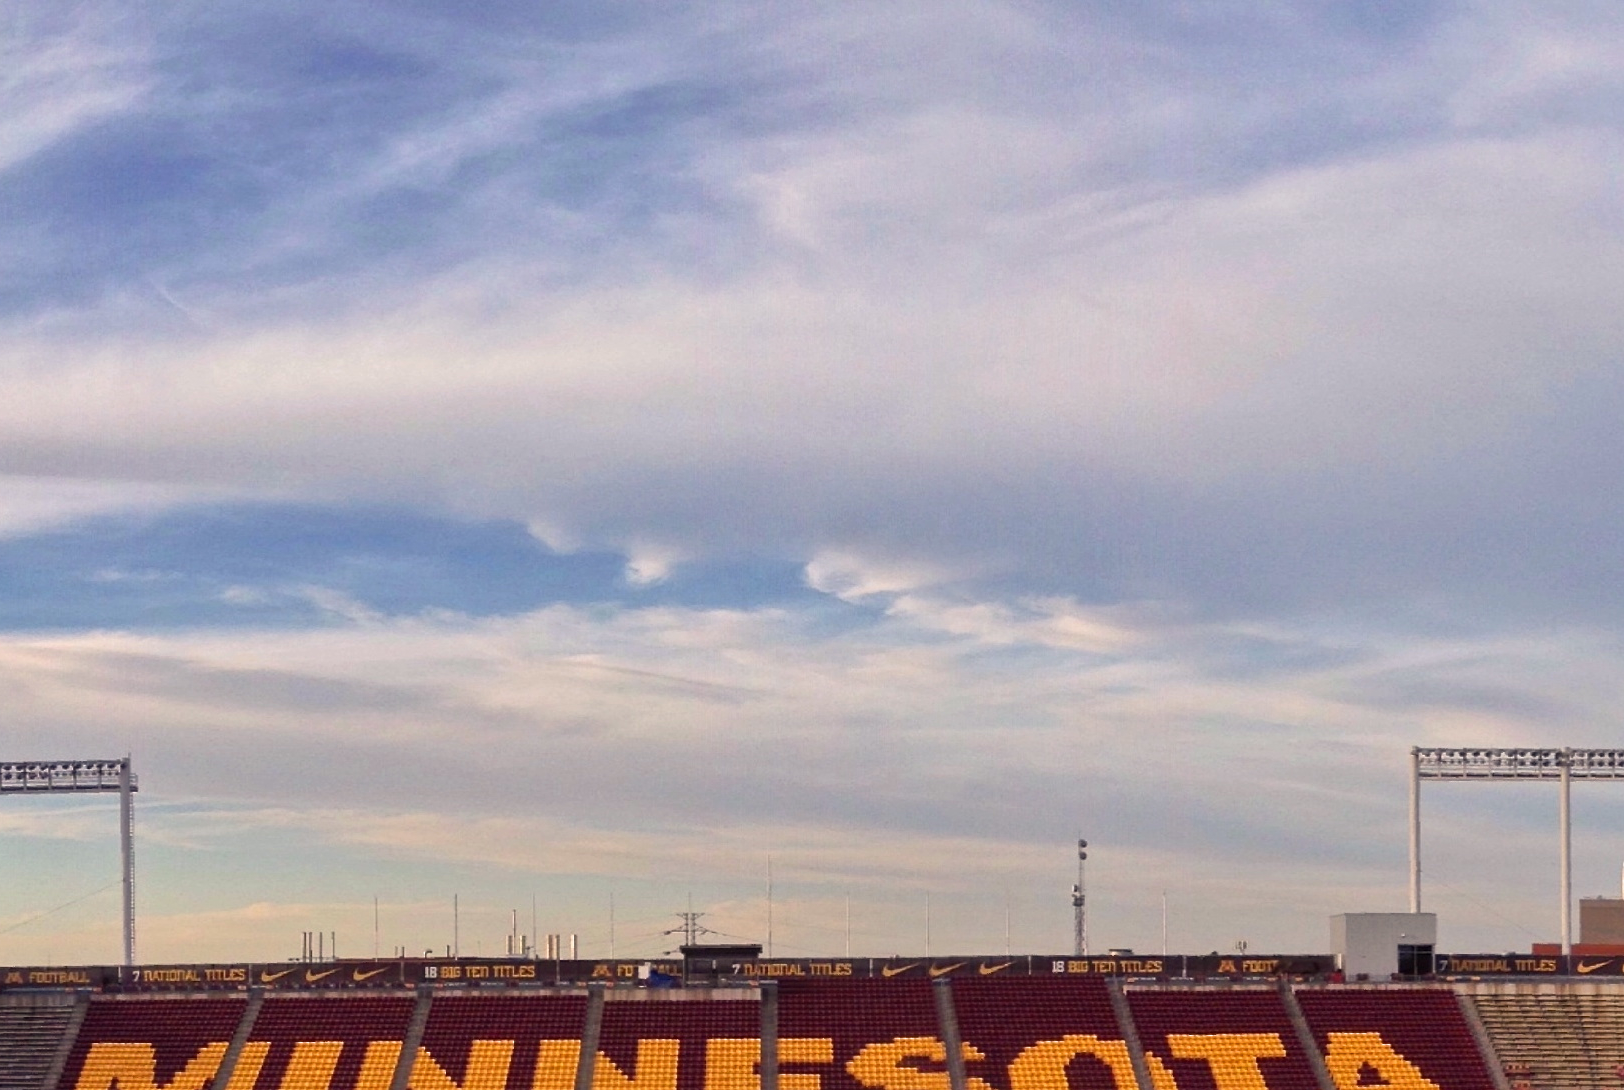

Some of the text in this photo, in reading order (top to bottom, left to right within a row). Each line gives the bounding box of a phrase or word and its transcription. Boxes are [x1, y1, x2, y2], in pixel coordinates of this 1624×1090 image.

[440, 965, 461, 978] BIG
[493, 965, 535, 978] TITLES
[810, 964, 851, 976] TITLES
[1068, 961, 1088, 973] BIG
[1120, 961, 1162, 973] TITLES
[1515, 959, 1556, 972] TITLES
[29, 972, 90, 984] FOOTBALL
[205, 970, 246, 982] TITLES
